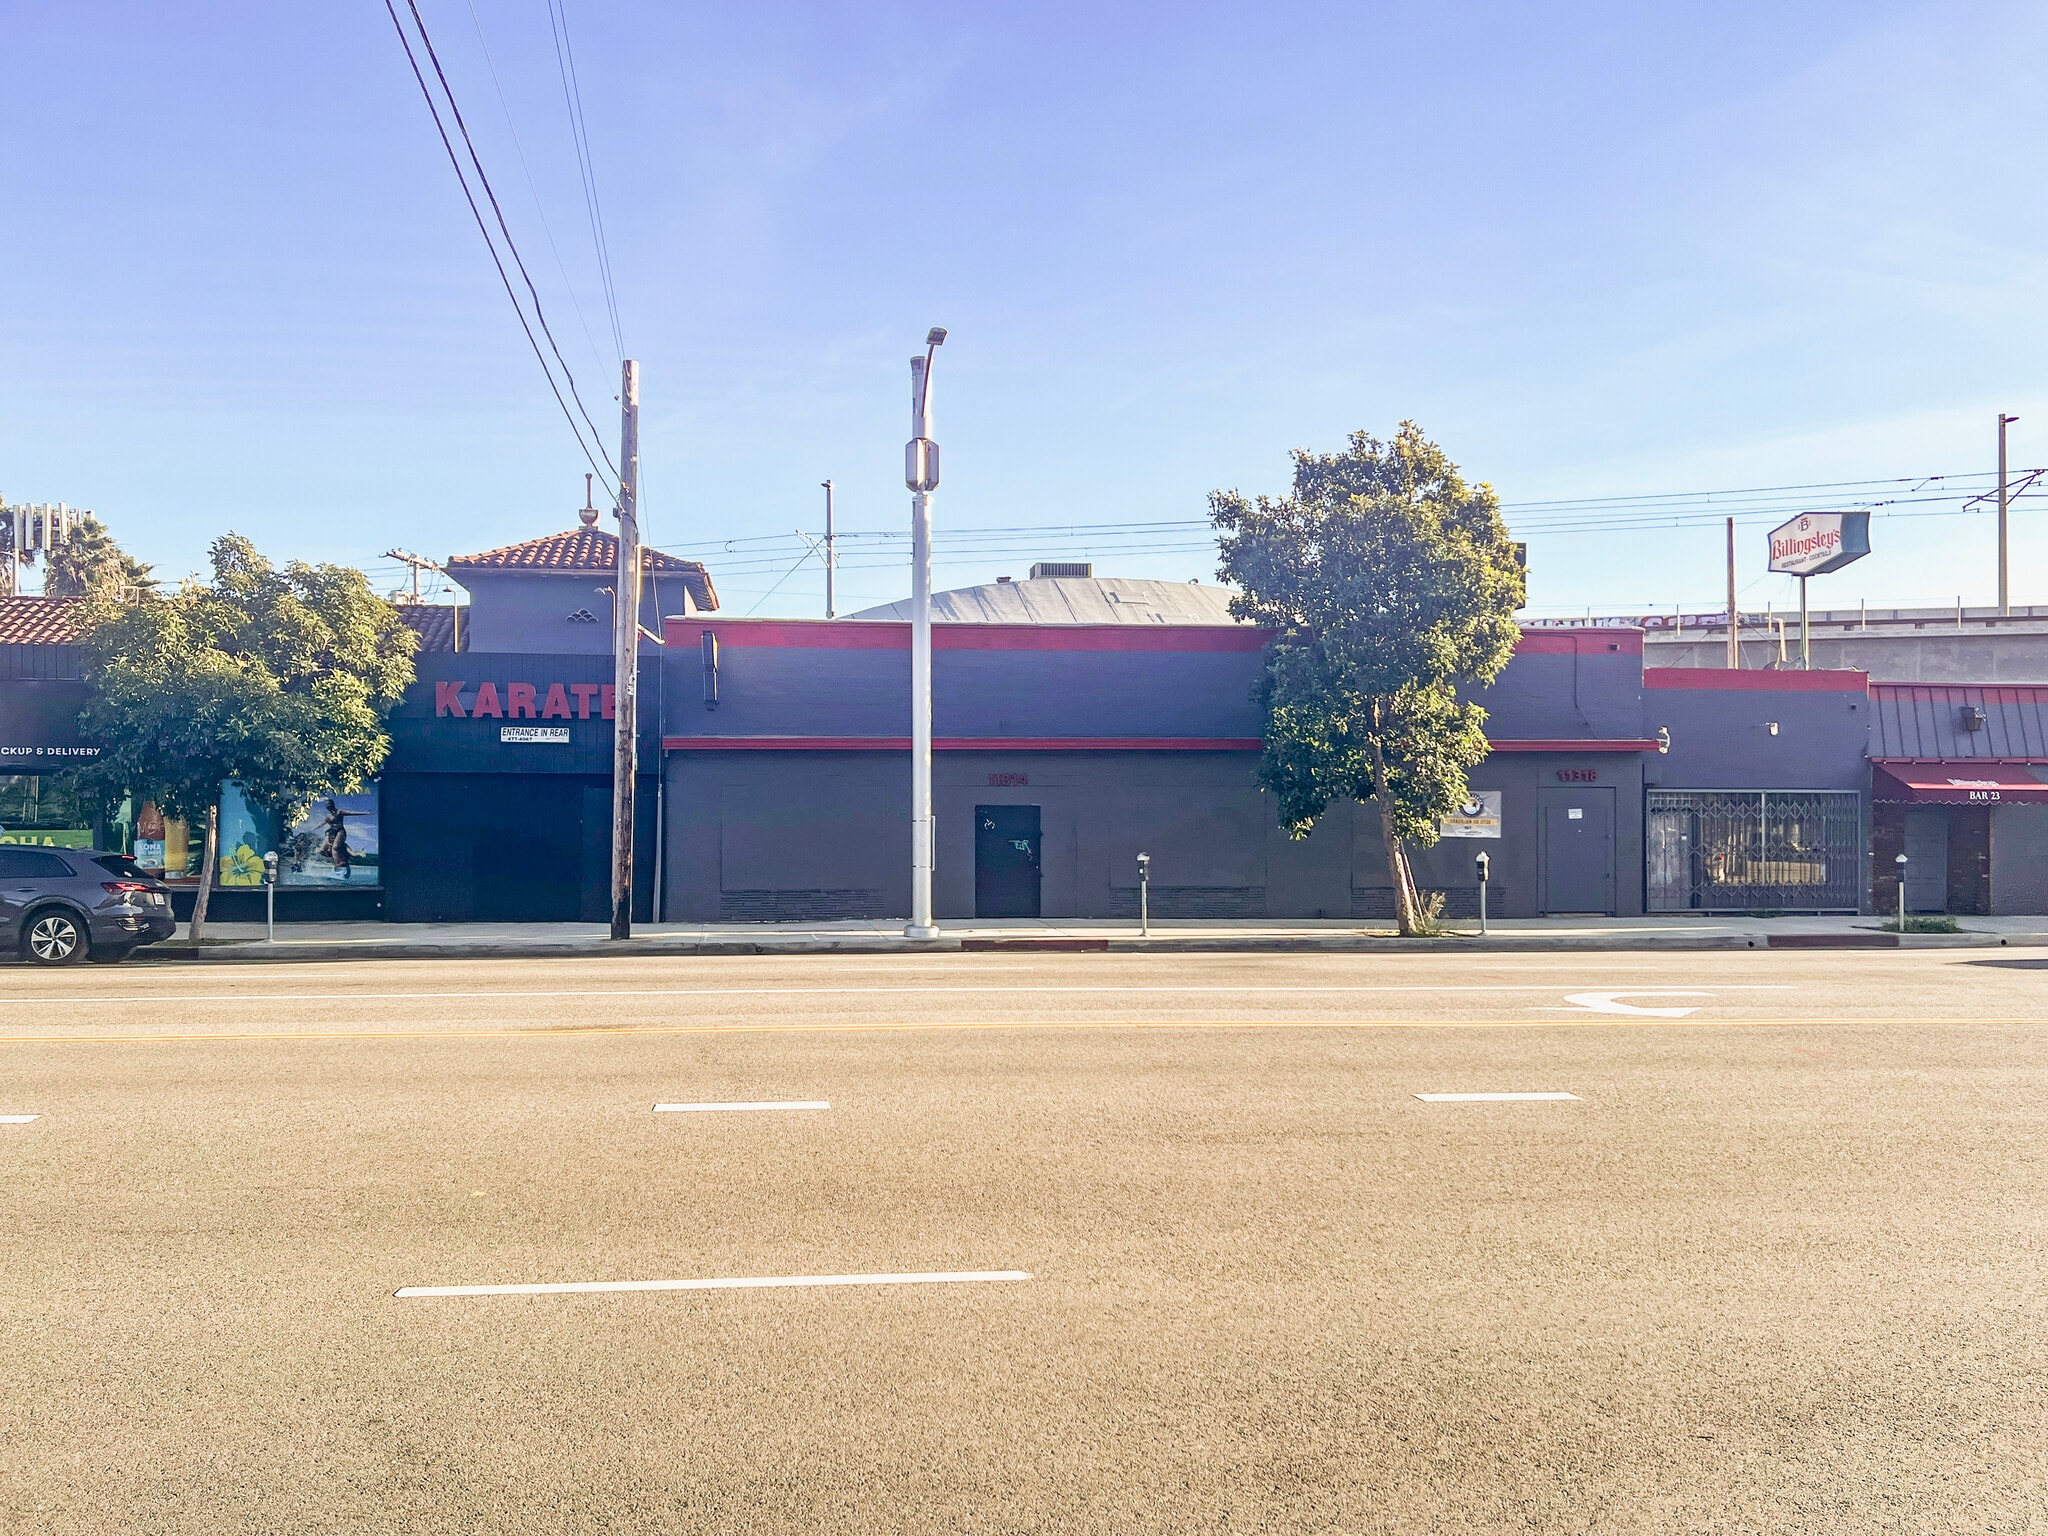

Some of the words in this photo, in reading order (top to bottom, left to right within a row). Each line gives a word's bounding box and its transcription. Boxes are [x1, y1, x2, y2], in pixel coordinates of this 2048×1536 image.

[1772, 529, 1840, 560] Billingsley's
[1809, 550, 1832, 561] COCKTAILS
[502, 728, 538, 737] ENTRANCE
[540, 729, 548, 737] IN
[549, 729, 569, 737] REAR
[36, 747, 43, 755] &
[47, 747, 101, 756] DELIVERY
[988, 773, 1028, 786] 11314
[1556, 769, 1600, 782] 11318
[1969, 791, 1988, 800] BAR
[1990, 791, 2001, 800] 23
